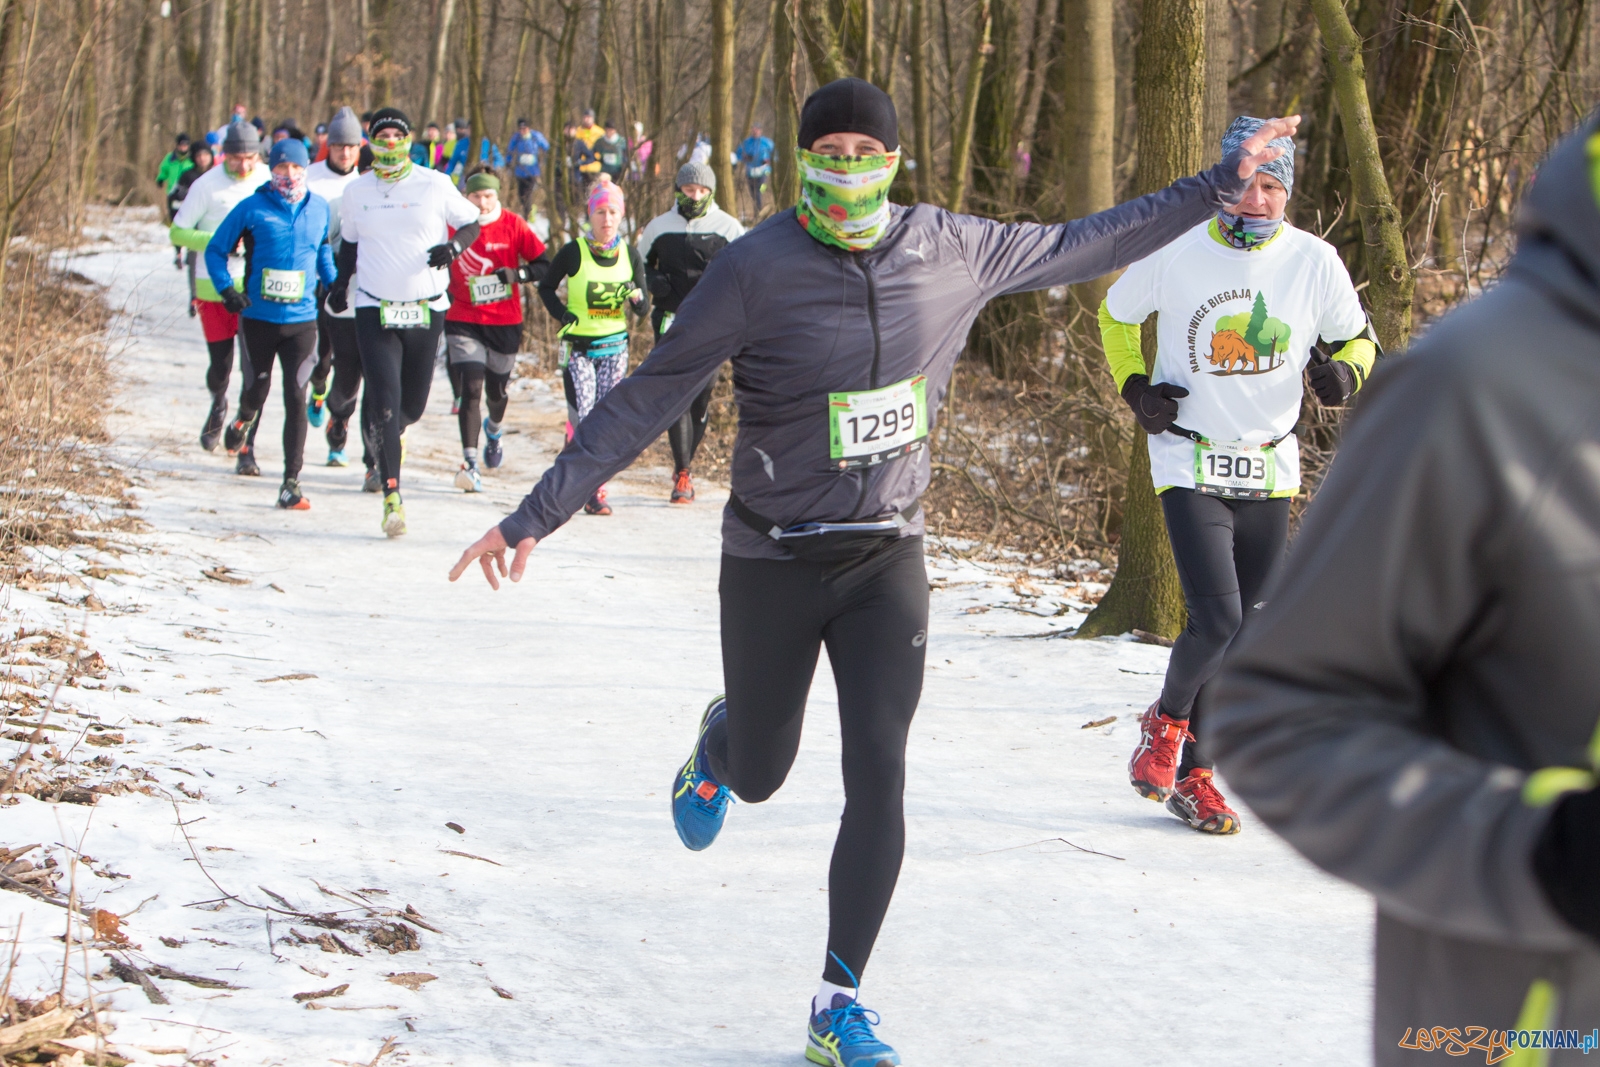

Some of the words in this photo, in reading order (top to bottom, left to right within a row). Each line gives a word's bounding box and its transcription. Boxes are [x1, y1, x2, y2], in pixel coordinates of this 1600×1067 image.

[266, 279, 300, 293] 2092
[476, 283, 506, 296] 1073
[391, 309, 419, 320] 703
[1187, 304, 1210, 374] NARAMOWICE
[1207, 289, 1252, 308] BIEGAJĄ
[847, 402, 915, 444] 1299
[1206, 454, 1265, 480] 1303
[1224, 479, 1250, 487] TOMASZ
